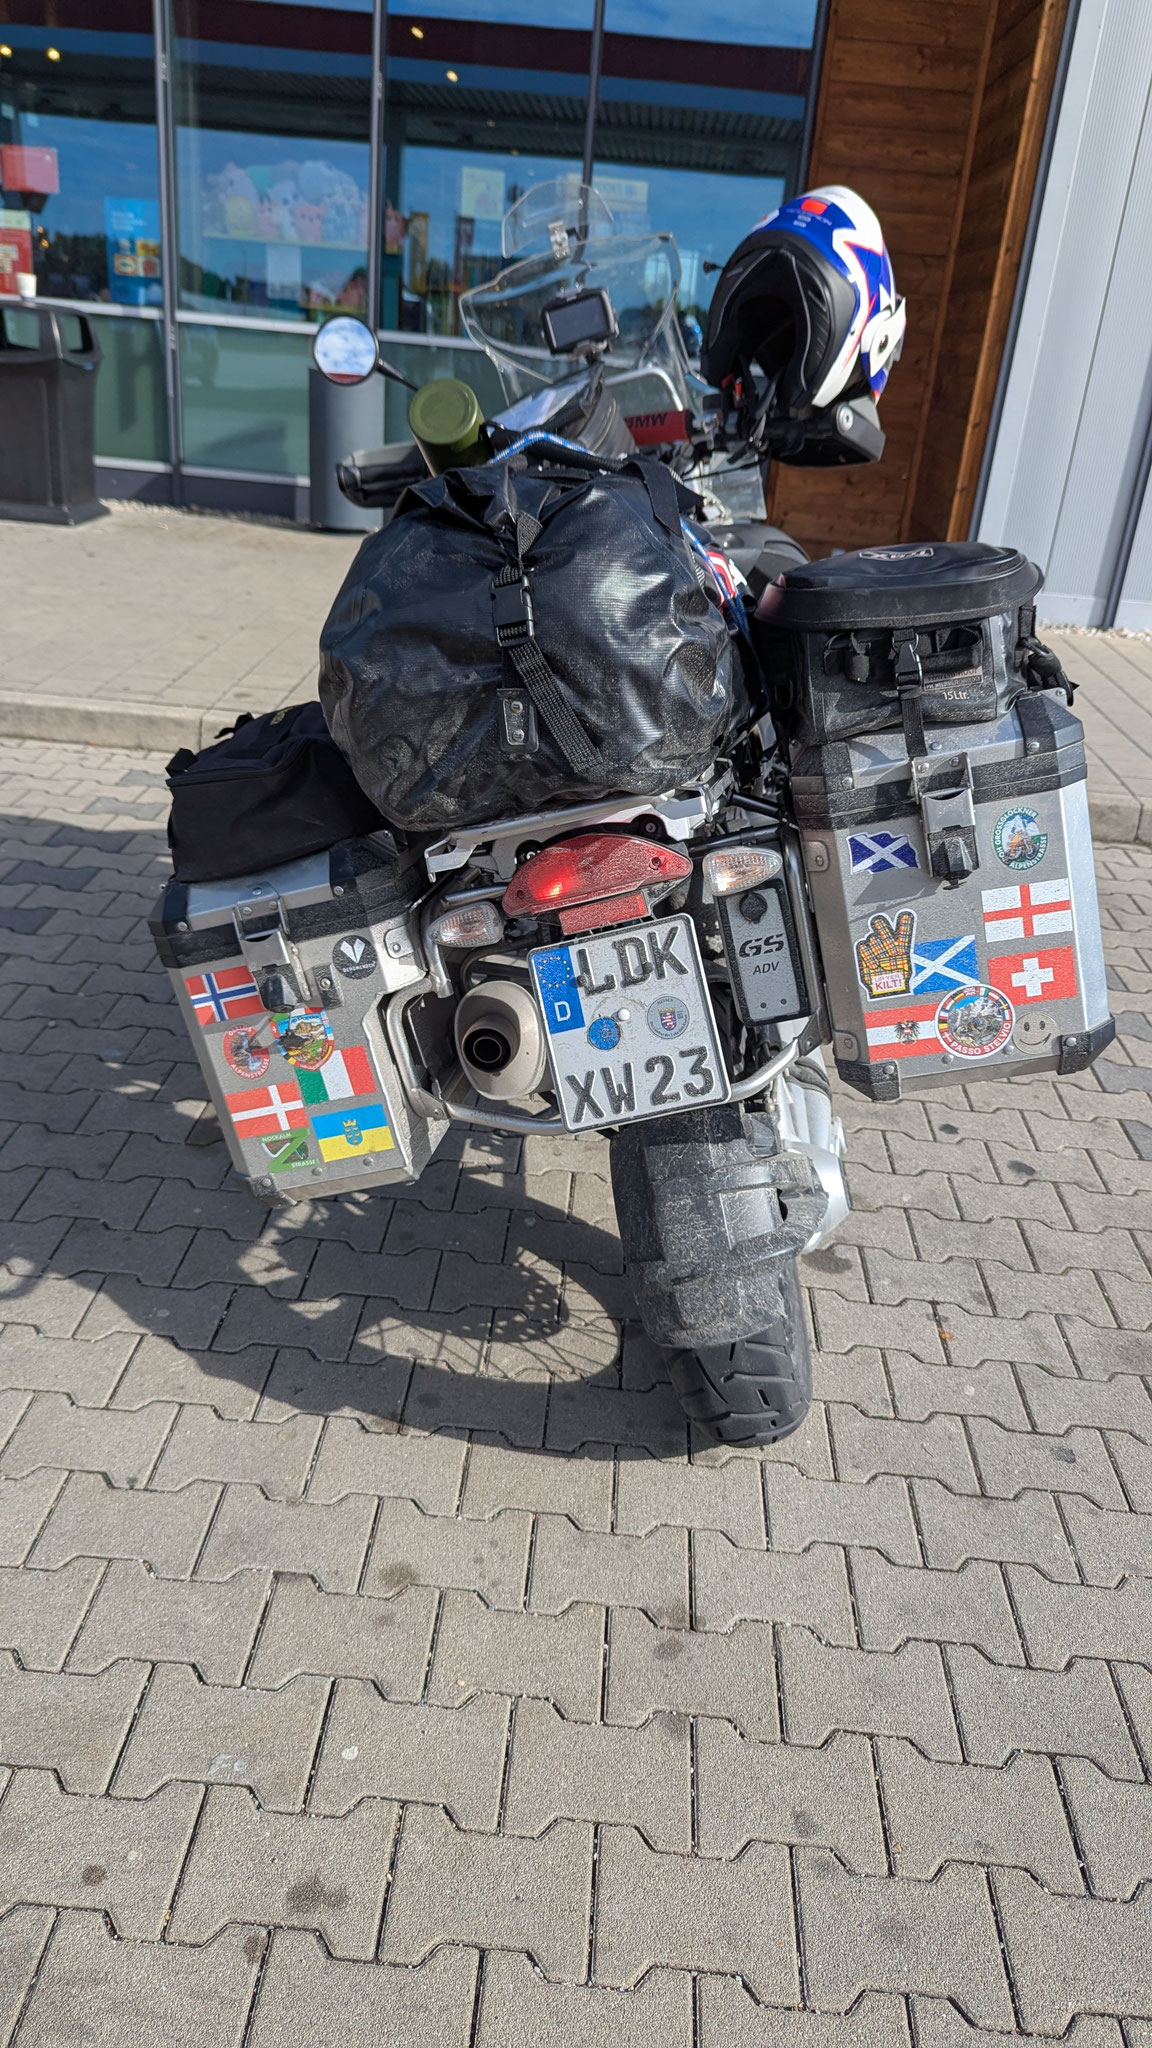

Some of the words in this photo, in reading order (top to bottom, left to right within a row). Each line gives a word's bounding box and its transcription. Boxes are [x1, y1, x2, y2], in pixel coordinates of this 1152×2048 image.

[994, 807, 1038, 845] GROSSGLOCKNER
[739, 933, 784, 958] GS
[576, 926, 690, 996] LDK
[753, 961, 780, 976] ADV
[874, 979, 903, 991] KILT!
[554, 1000, 572, 1022] D
[950, 1041, 981, 1055] PASSO
[983, 1021, 1011, 1053] STELVIO
[231, 1058, 270, 1079] ALPENSTRASSE
[565, 1062, 636, 1123] XW
[645, 1046, 715, 1106] 23
[291, 1160, 317, 1168] STRASSE
